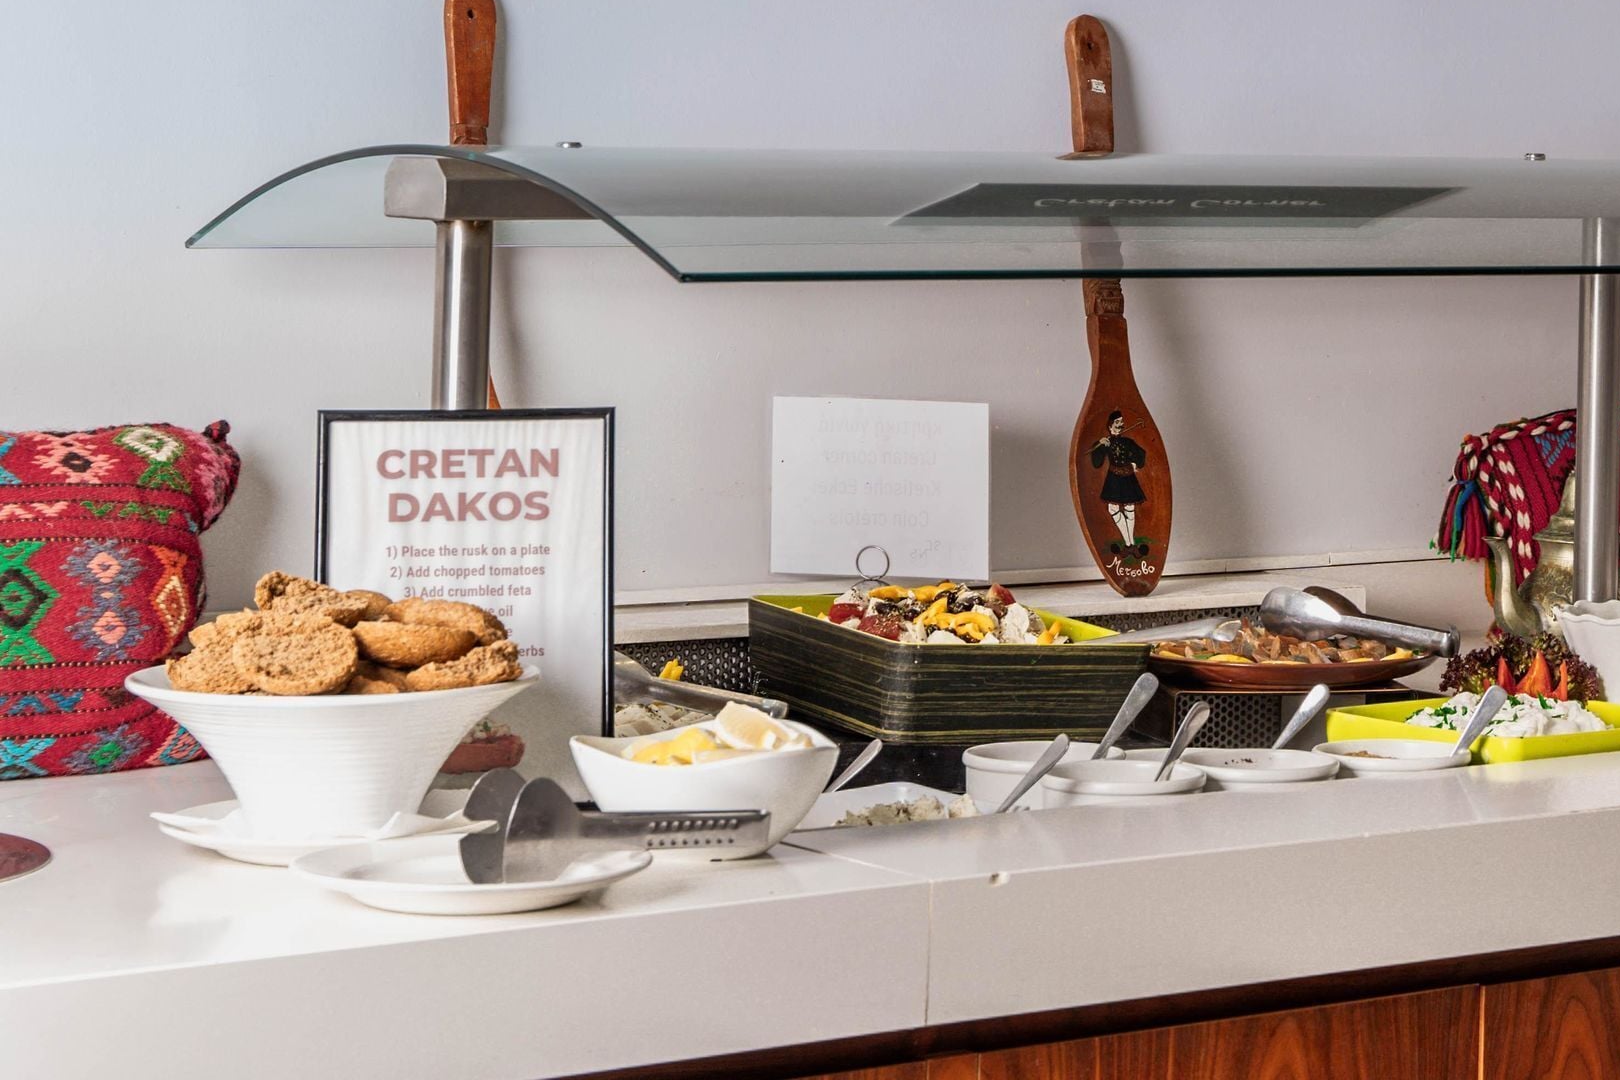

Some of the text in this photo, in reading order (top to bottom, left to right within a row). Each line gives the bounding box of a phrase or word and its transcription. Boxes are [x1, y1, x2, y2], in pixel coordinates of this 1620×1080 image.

[376, 447, 560, 480] CRETAN
[387, 490, 551, 523] DAKOS
[385, 543, 551, 560] 1) Place the rusk on a plate
[390, 564, 545, 580] 2) Add chopped tomatoes
[403, 584, 532, 599] 3) Add crumbled feta
[498, 605, 513, 617] oil
[518, 645, 545, 657] erbs
